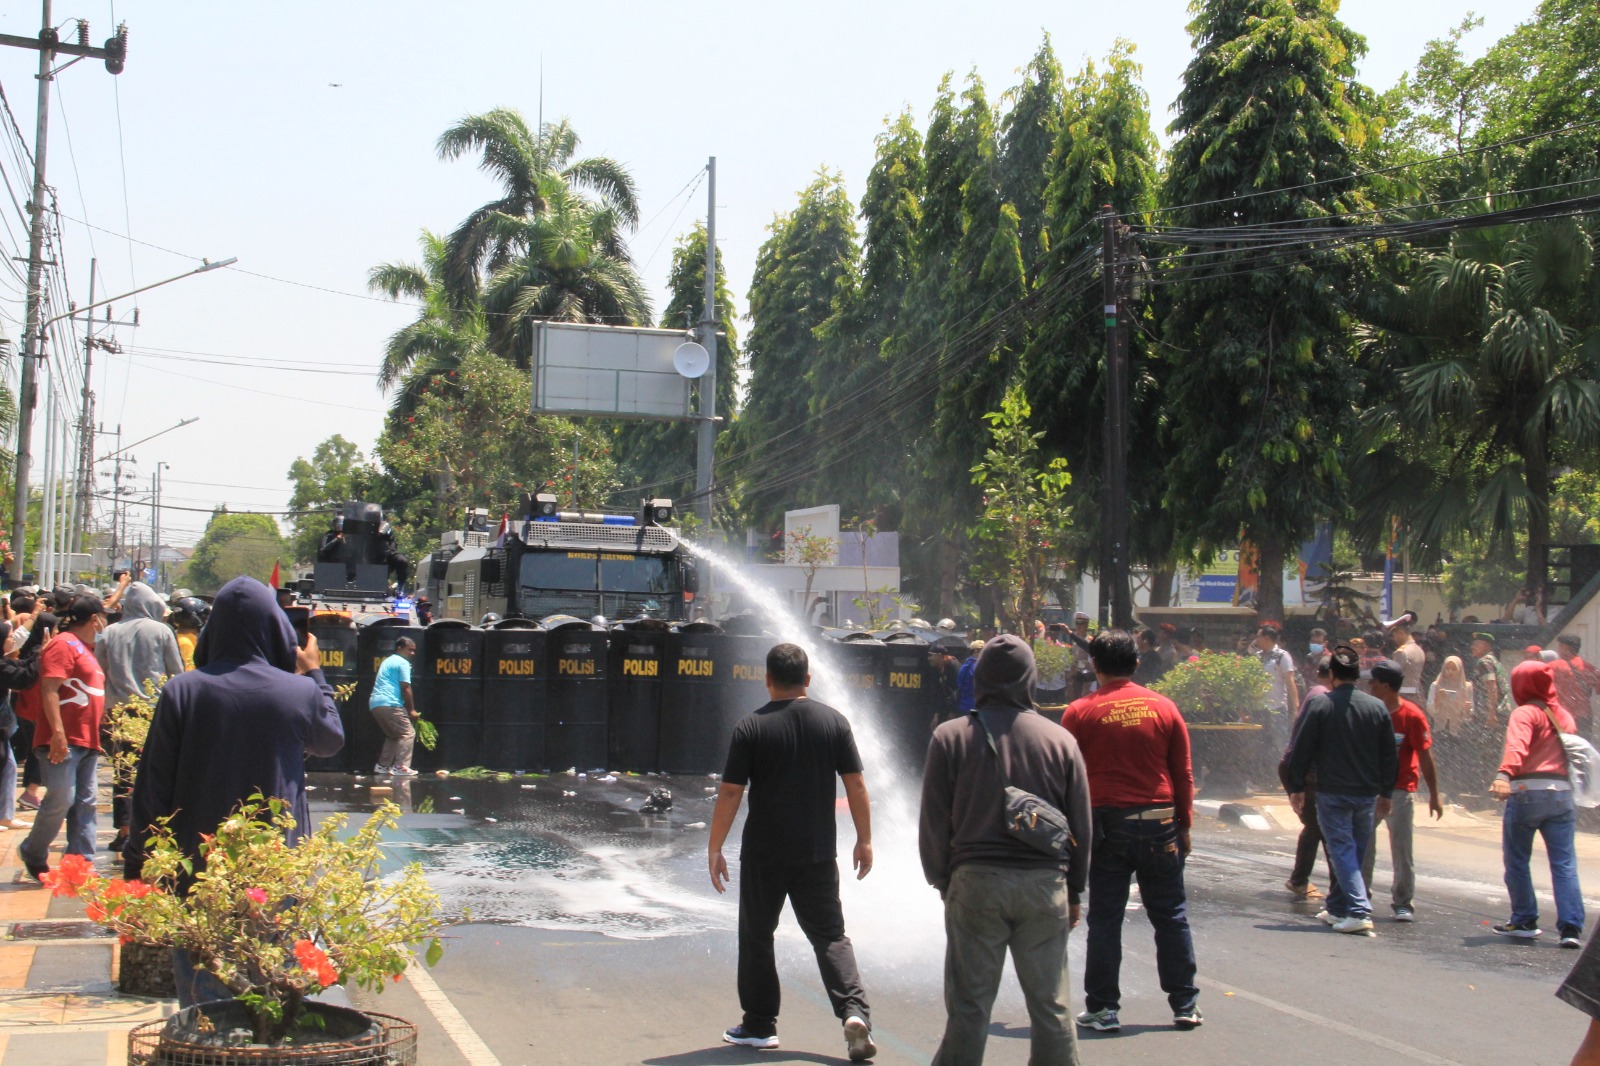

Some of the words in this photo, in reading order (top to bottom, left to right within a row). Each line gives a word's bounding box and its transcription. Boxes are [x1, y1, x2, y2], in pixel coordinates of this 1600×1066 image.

[436, 658, 472, 674] POLISI
[498, 660, 534, 674] POLISI
[559, 659, 594, 674] POLISI
[623, 659, 658, 676] POLISI
[678, 659, 713, 676] POLISI
[890, 672, 921, 689] POLISI
